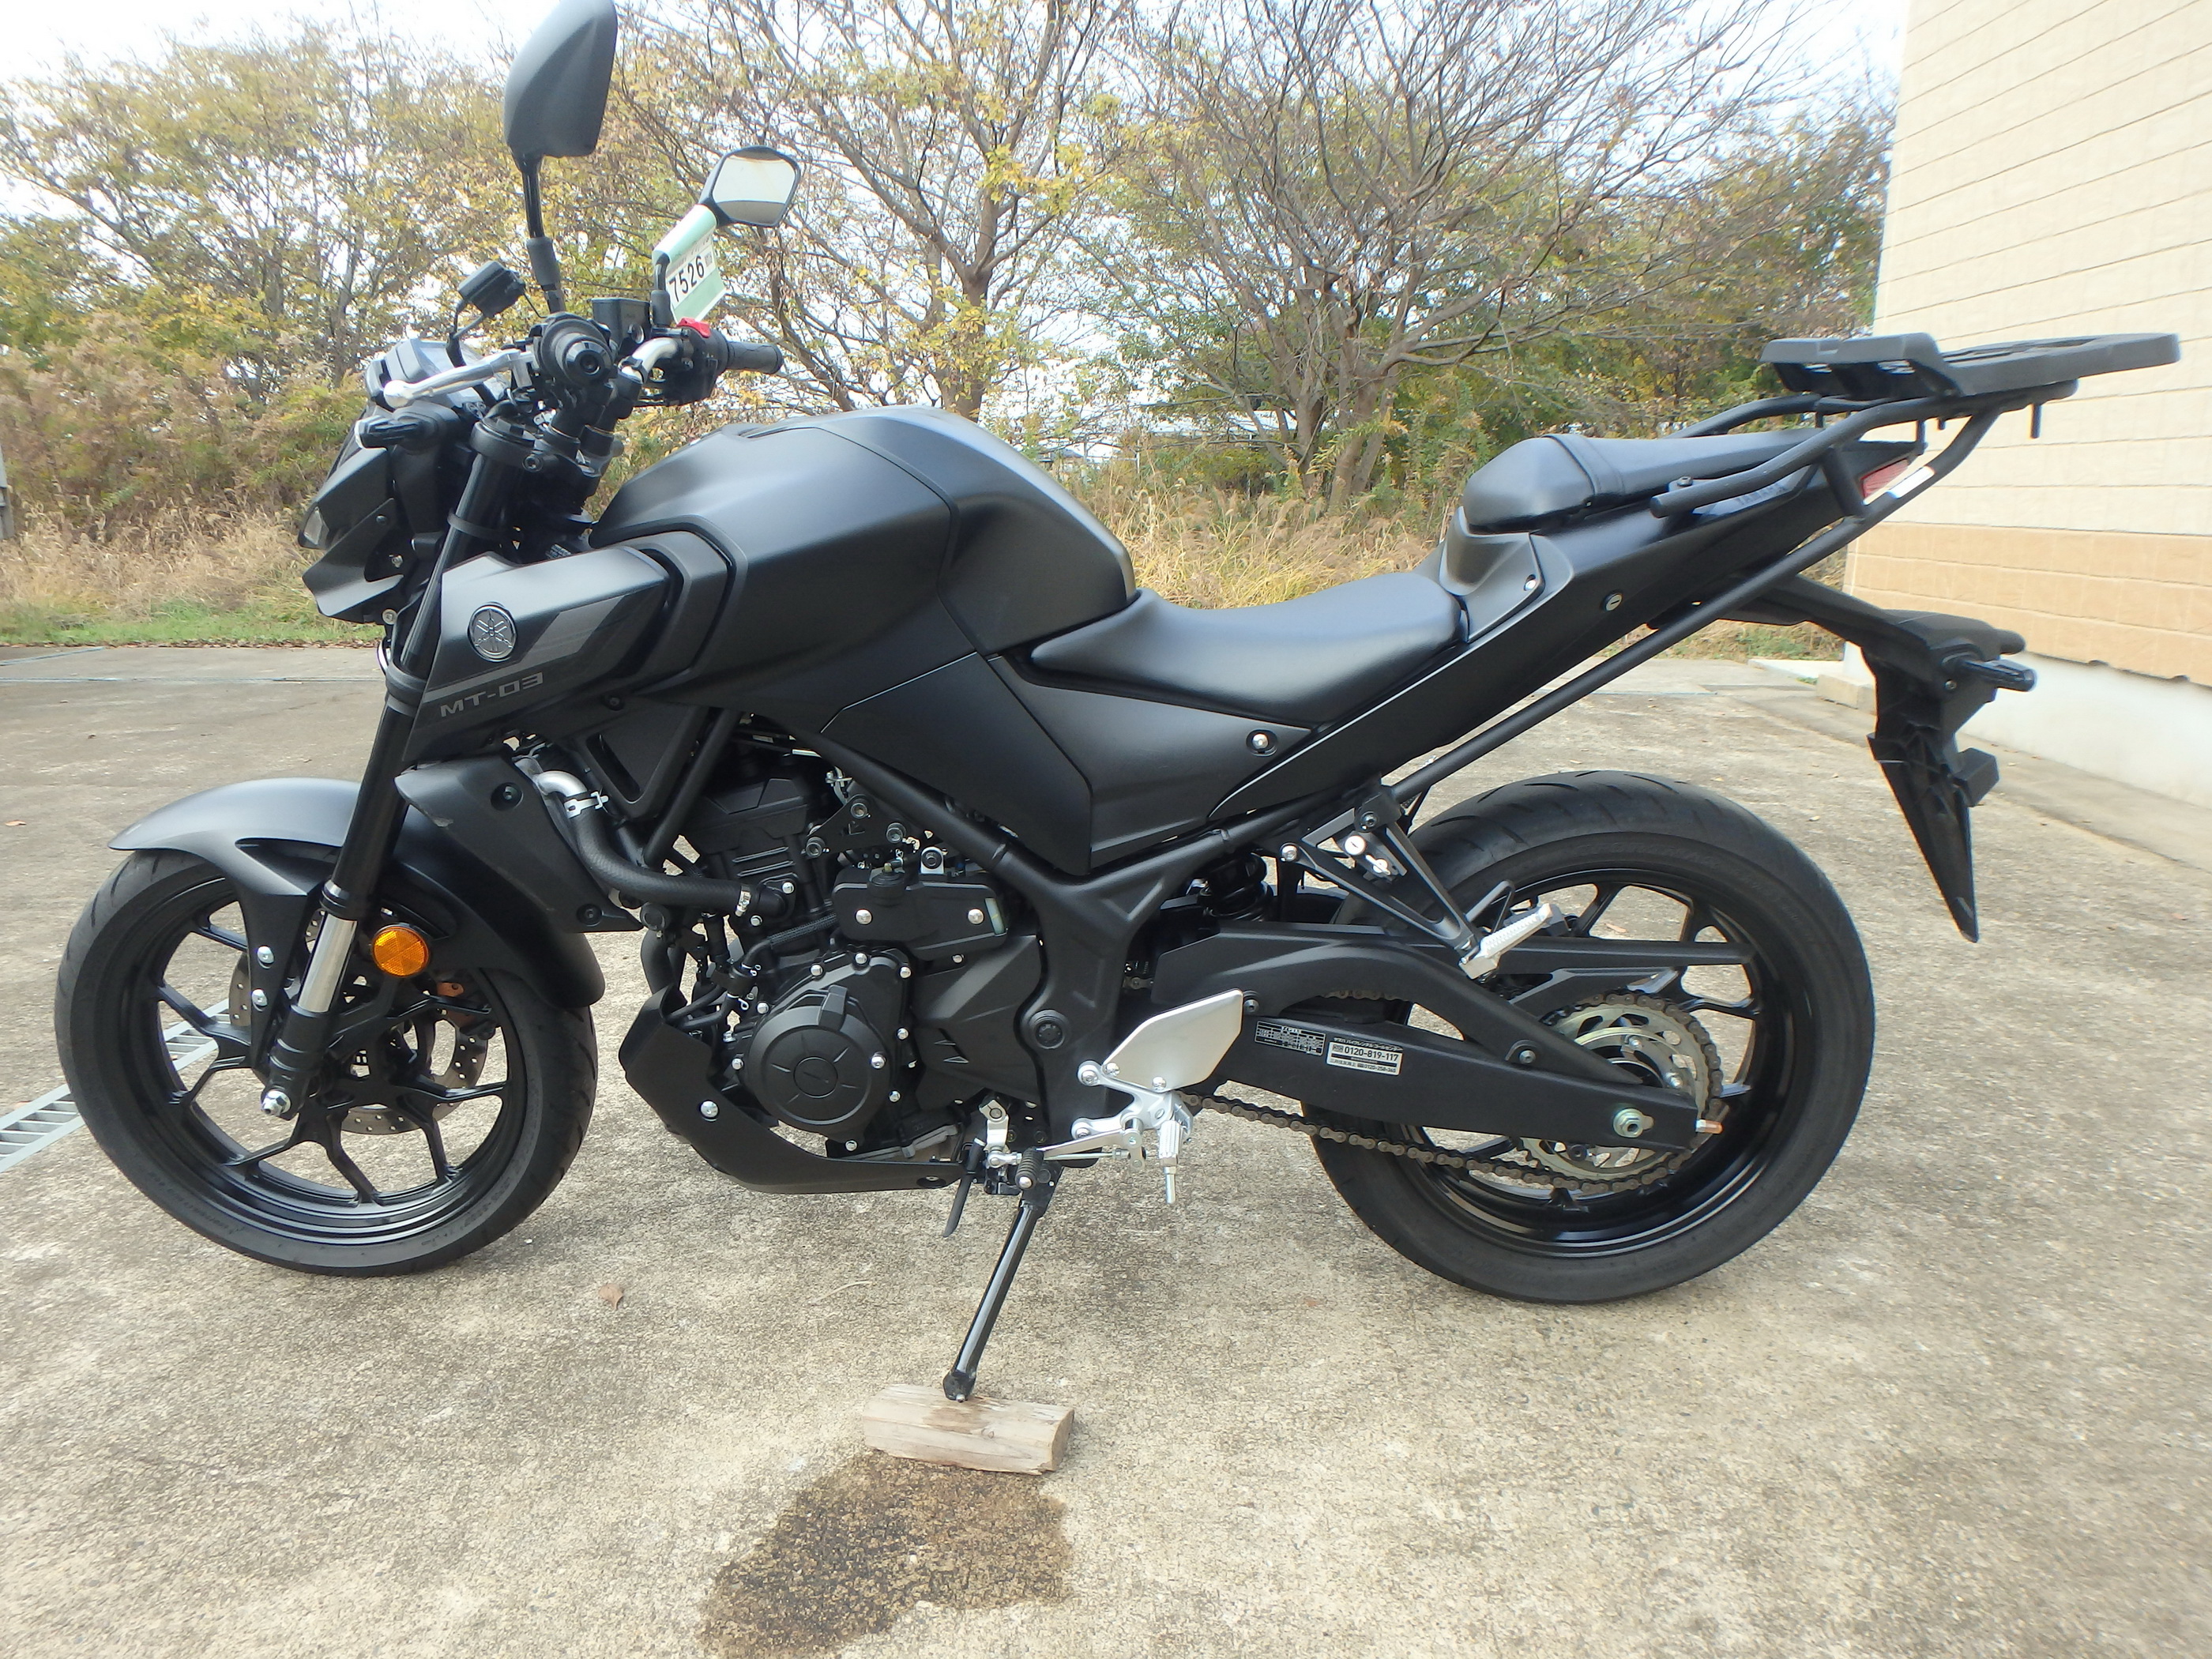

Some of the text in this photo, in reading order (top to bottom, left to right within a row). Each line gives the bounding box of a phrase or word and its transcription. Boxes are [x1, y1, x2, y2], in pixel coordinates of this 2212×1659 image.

[668, 255, 705, 302] 7526
[440, 672, 544, 717] MT-03
[1345, 1047, 1399, 1061] 0120-819-117
